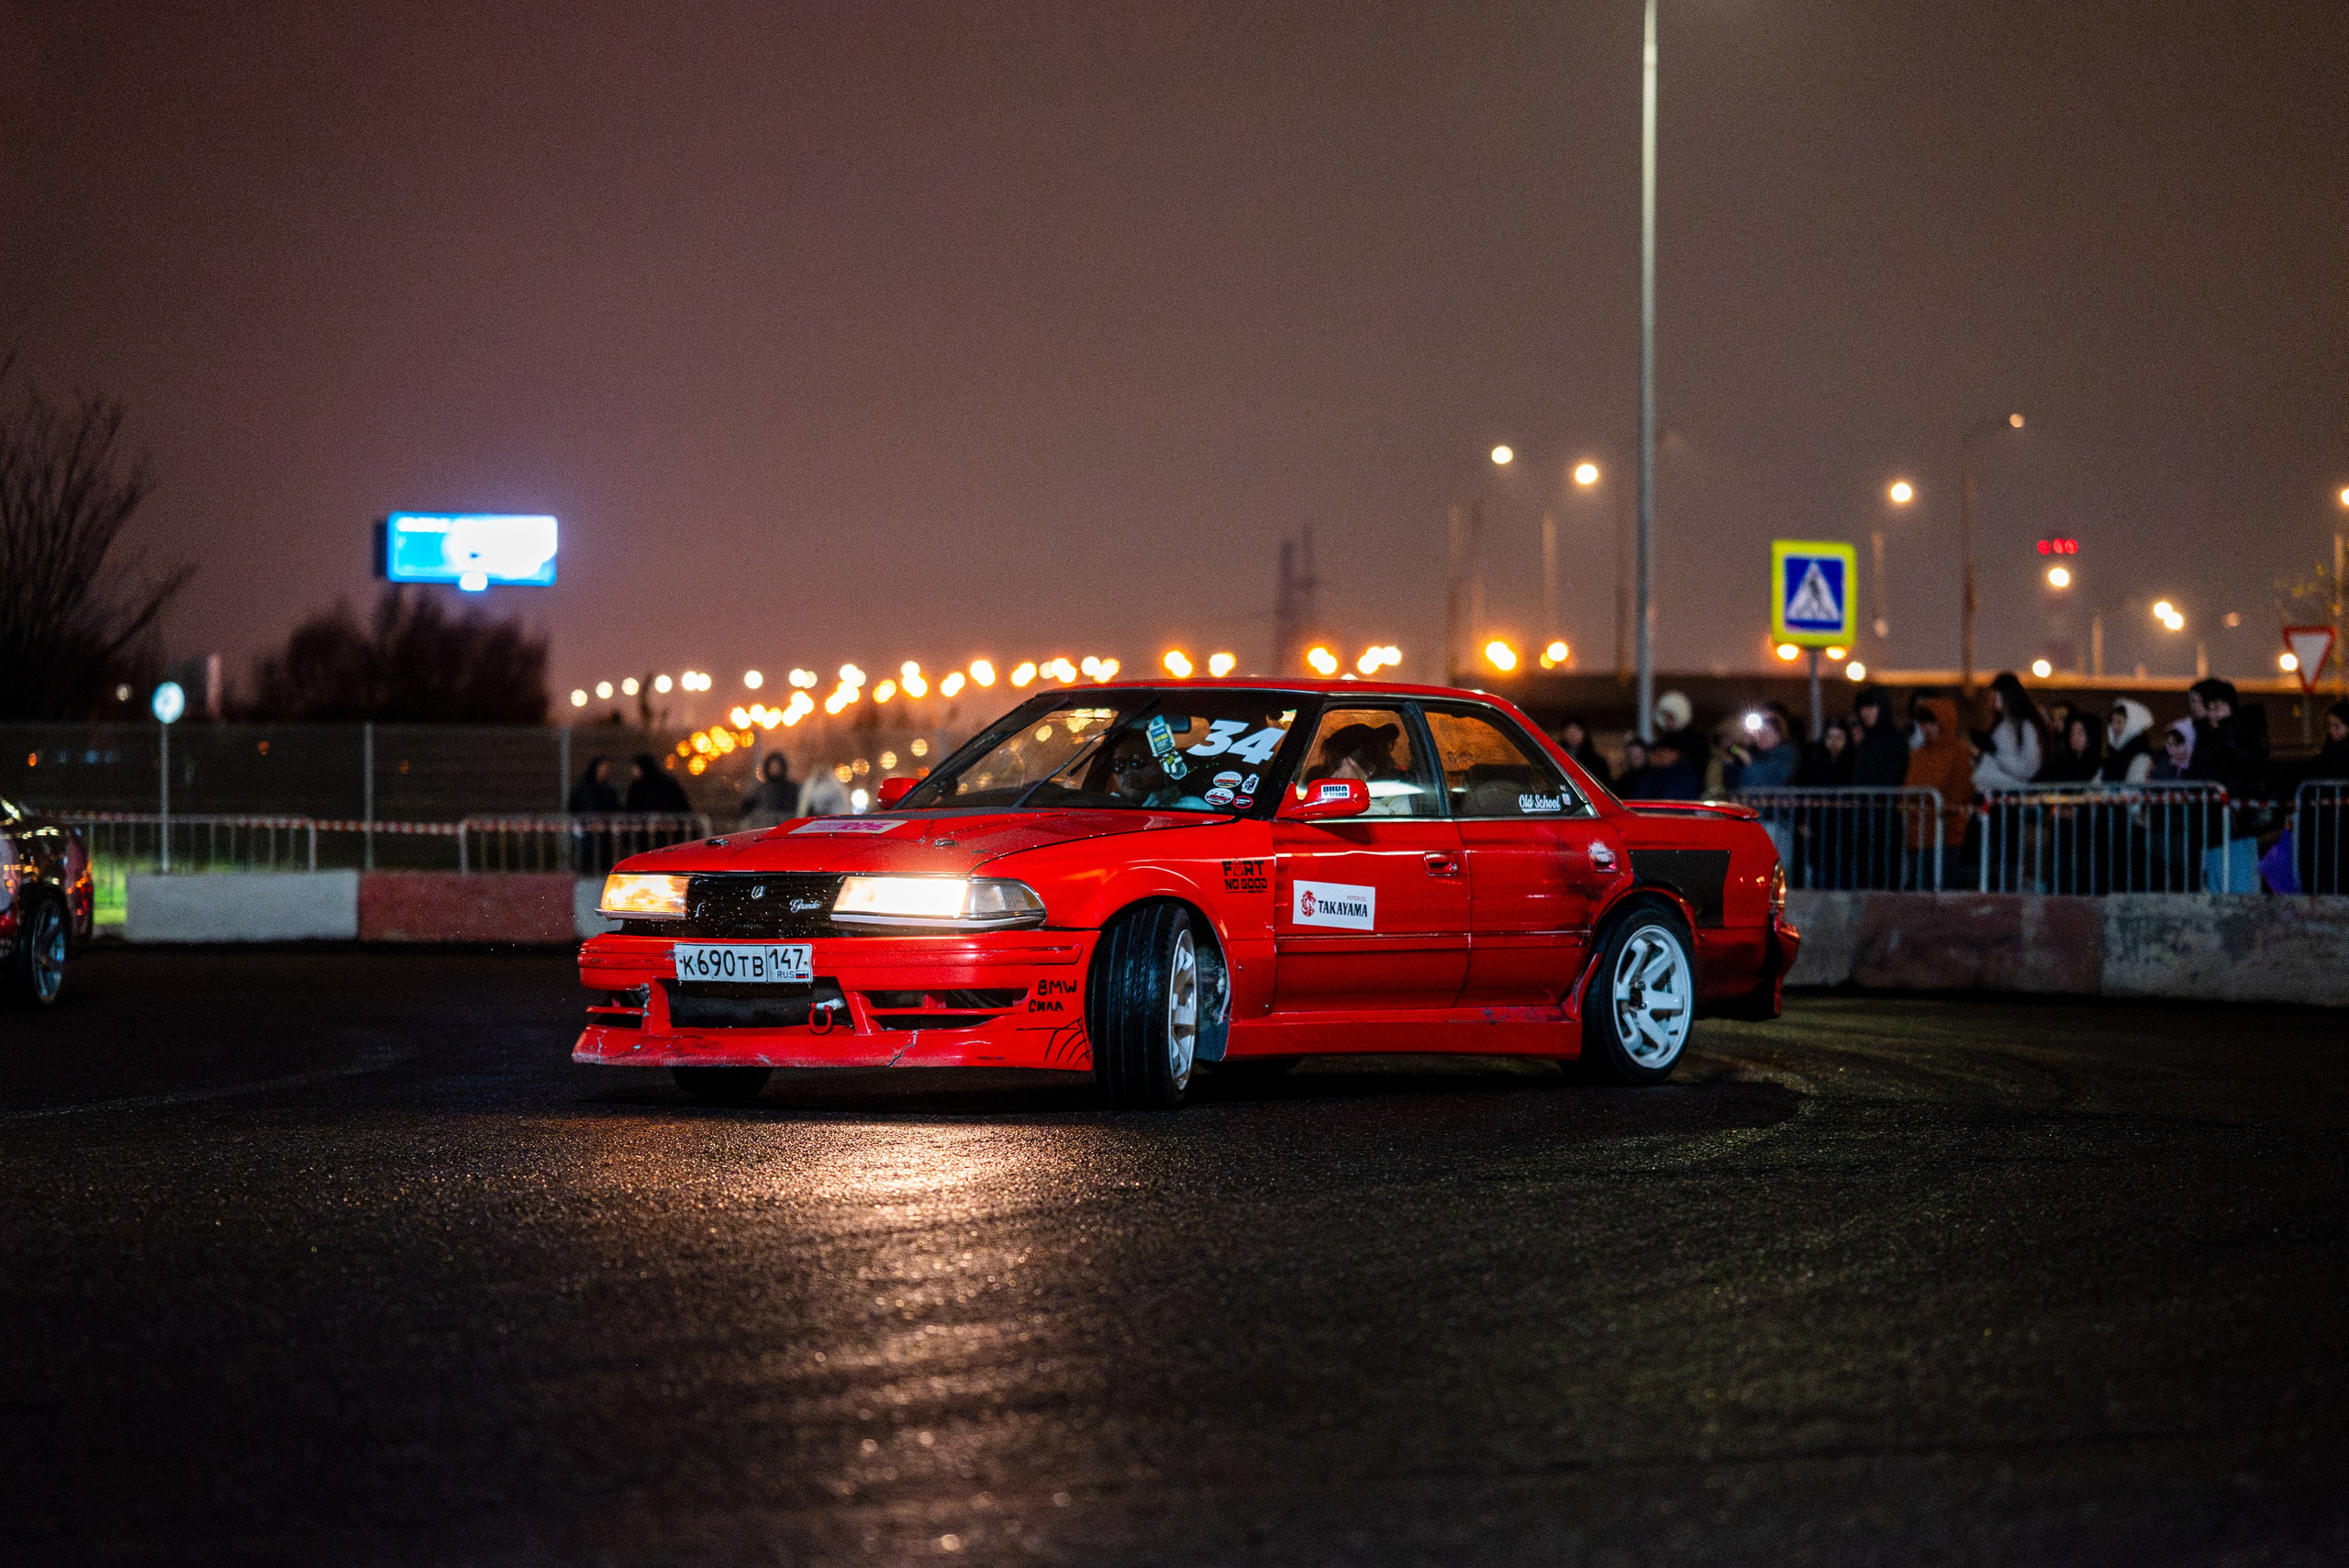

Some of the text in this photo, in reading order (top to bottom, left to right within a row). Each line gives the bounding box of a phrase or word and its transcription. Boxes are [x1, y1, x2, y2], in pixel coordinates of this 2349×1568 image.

[1186, 719, 1286, 765] 34
[1519, 794, 1561, 809] Old School
[1224, 877, 1267, 890] NO GOOD
[1318, 900, 1368, 917] TAKAYAMA
[769, 948, 804, 970] 147
[776, 971, 795, 979] RUS
[1037, 979, 1077, 995] BMW
